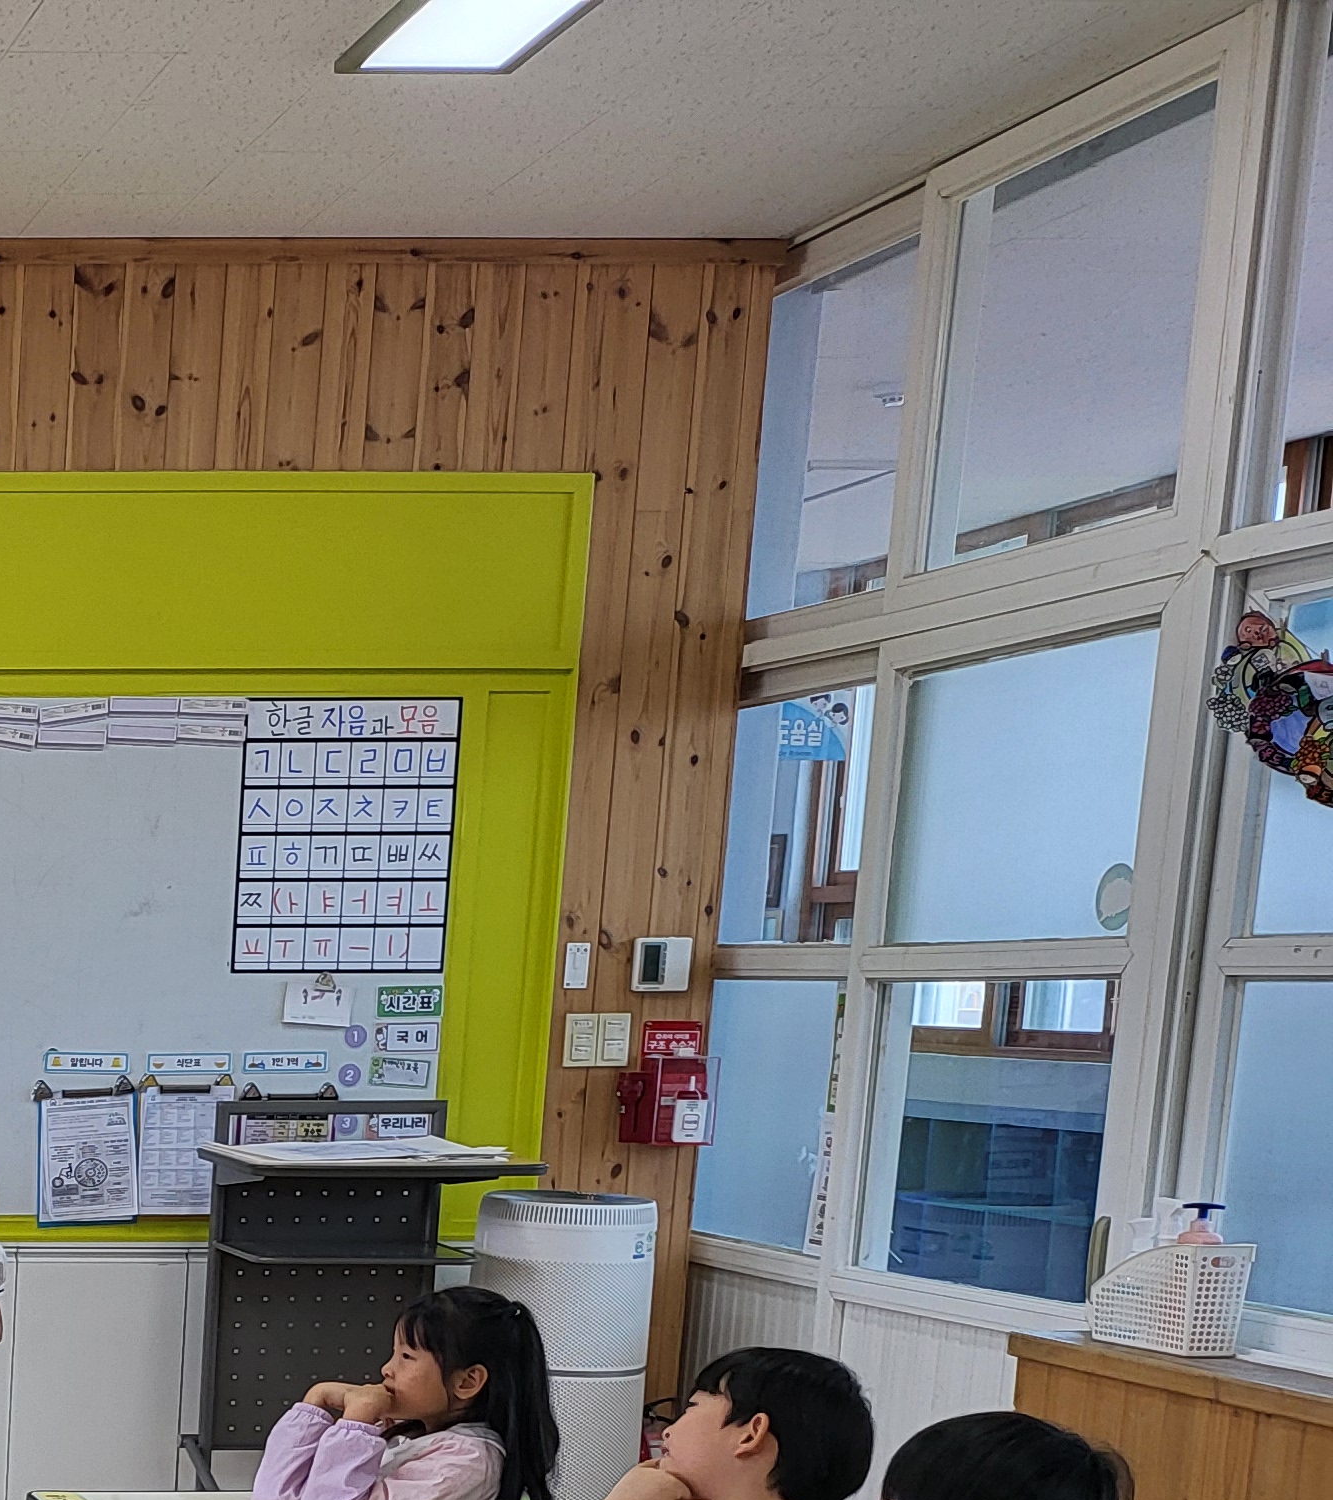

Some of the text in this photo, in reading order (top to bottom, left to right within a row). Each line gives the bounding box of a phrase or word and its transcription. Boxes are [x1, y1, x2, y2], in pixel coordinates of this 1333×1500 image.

[266, 702, 314, 736] 한글
[397, 705, 439, 734] 모음
[255, 749, 445, 773] ㄱ ㄴ ㄷ ㄹ ㅁ ㅂ
[248, 798, 270, 819] ㅅ
[317, 799, 338, 816] ㅈ
[353, 795, 372, 817] ㅊ
[392, 800, 408, 817] ㅋ
[427, 799, 443, 817] ㅌ
[283, 842, 302, 864] ㅎ
[386, 995, 433, 1010] 시간표
[353, 1030, 427, 1043] 1 국 어
[176, 1058, 201, 1067] 식단표
[345, 1070, 354, 1081] 2
[342, 1117, 426, 1129] 3 우리나라
